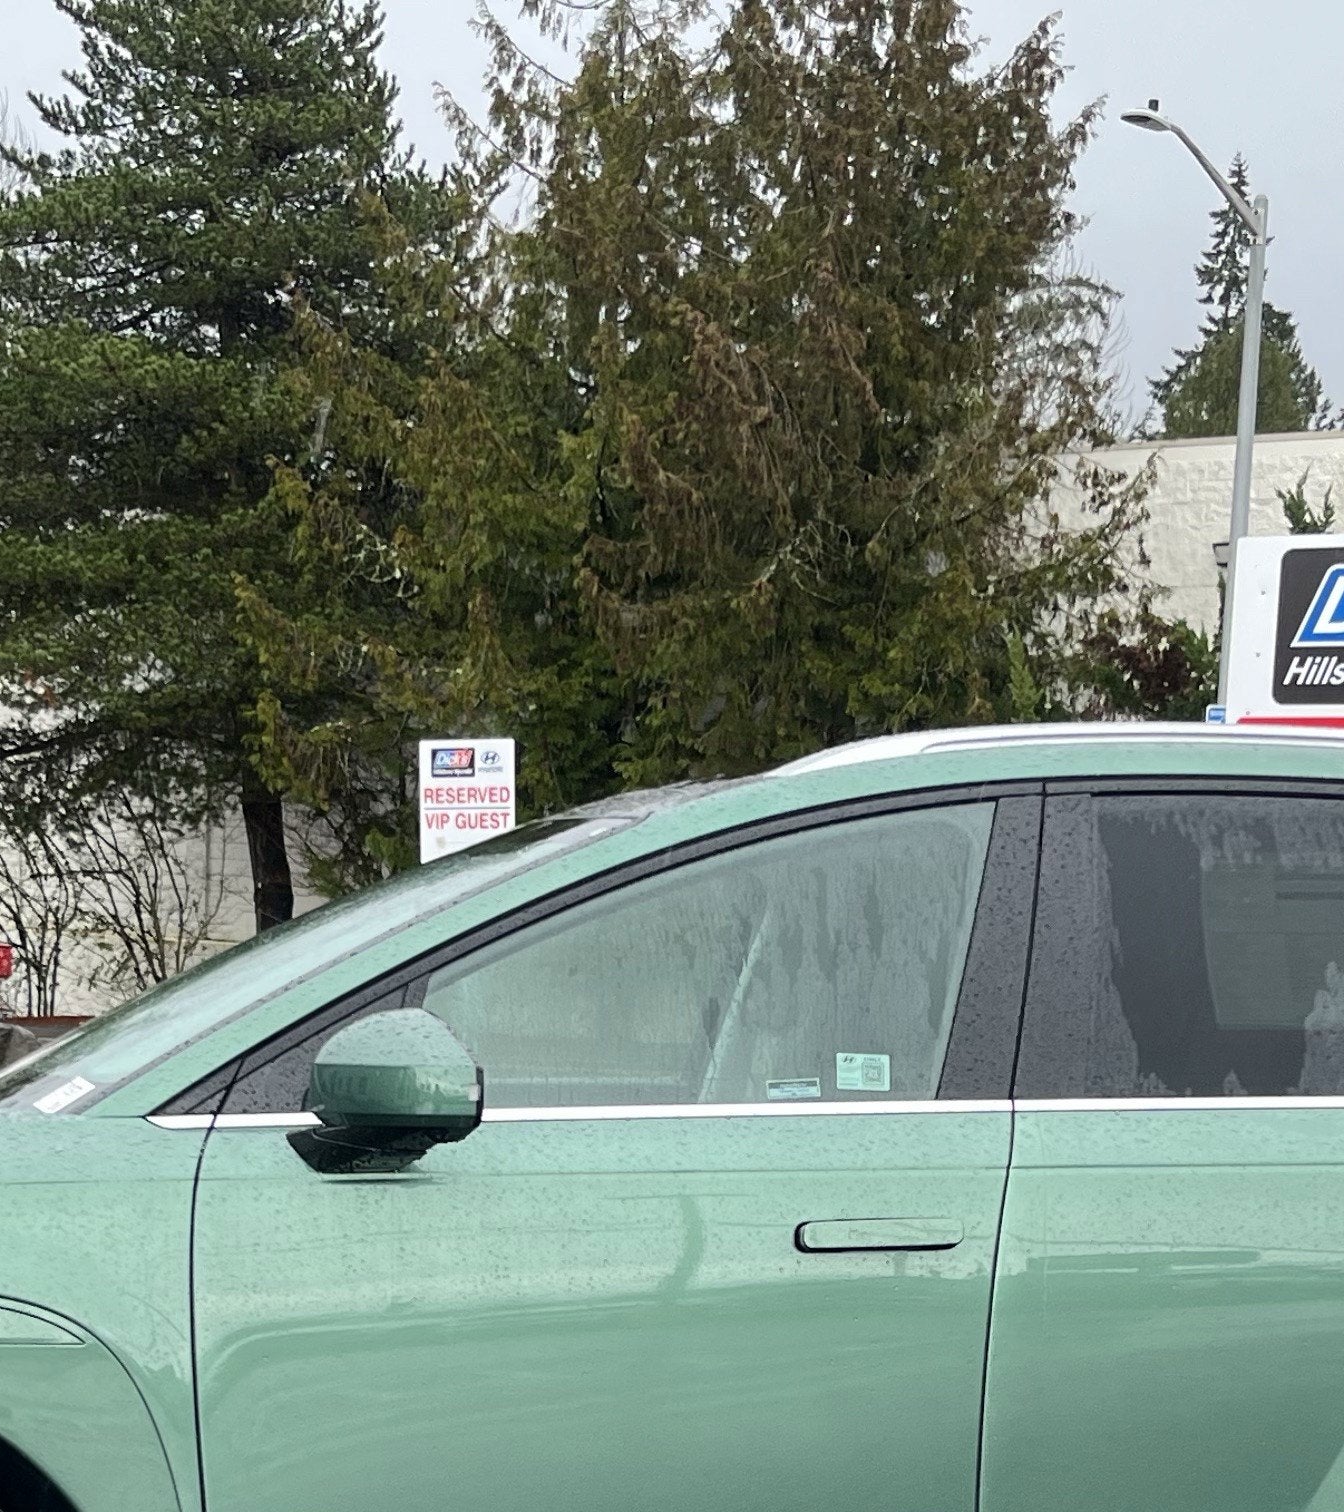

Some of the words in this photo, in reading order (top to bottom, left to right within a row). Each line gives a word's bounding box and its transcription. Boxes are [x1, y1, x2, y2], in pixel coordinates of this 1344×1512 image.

[424, 786, 511, 804] RESERVED
[425, 812, 450, 829] VIP
[455, 812, 510, 830] GUEST
